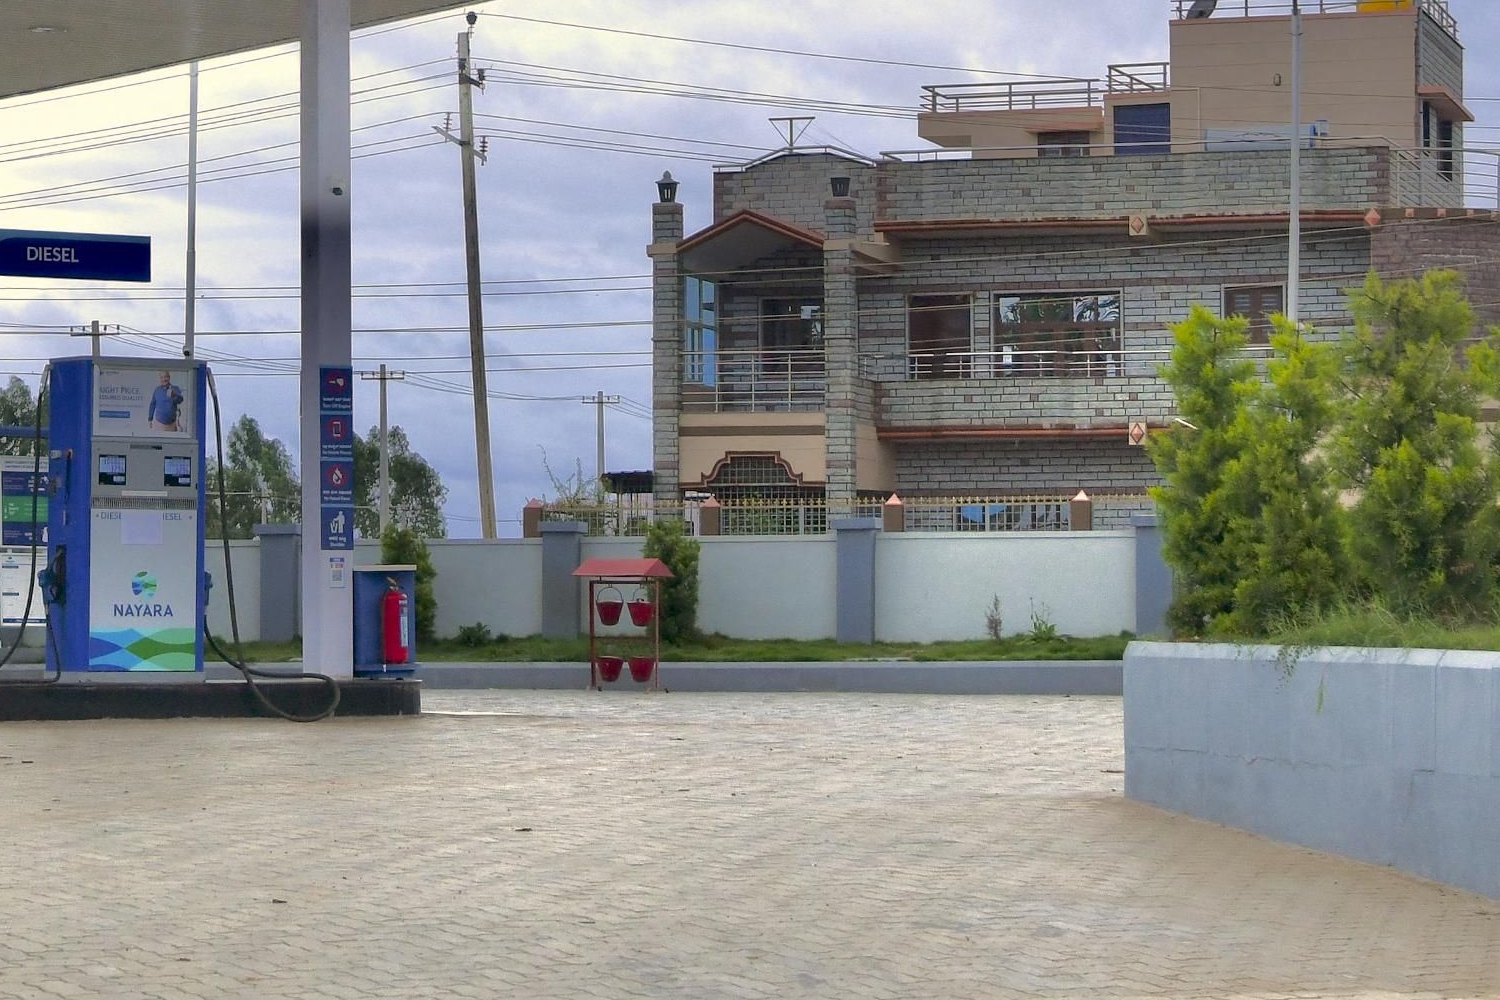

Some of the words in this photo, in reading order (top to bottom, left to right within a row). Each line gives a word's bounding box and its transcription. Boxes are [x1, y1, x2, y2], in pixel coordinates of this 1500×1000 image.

[26, 246, 79, 263] DIESEL
[162, 512, 182, 521] IESEL
[113, 603, 174, 617] NAYARA
